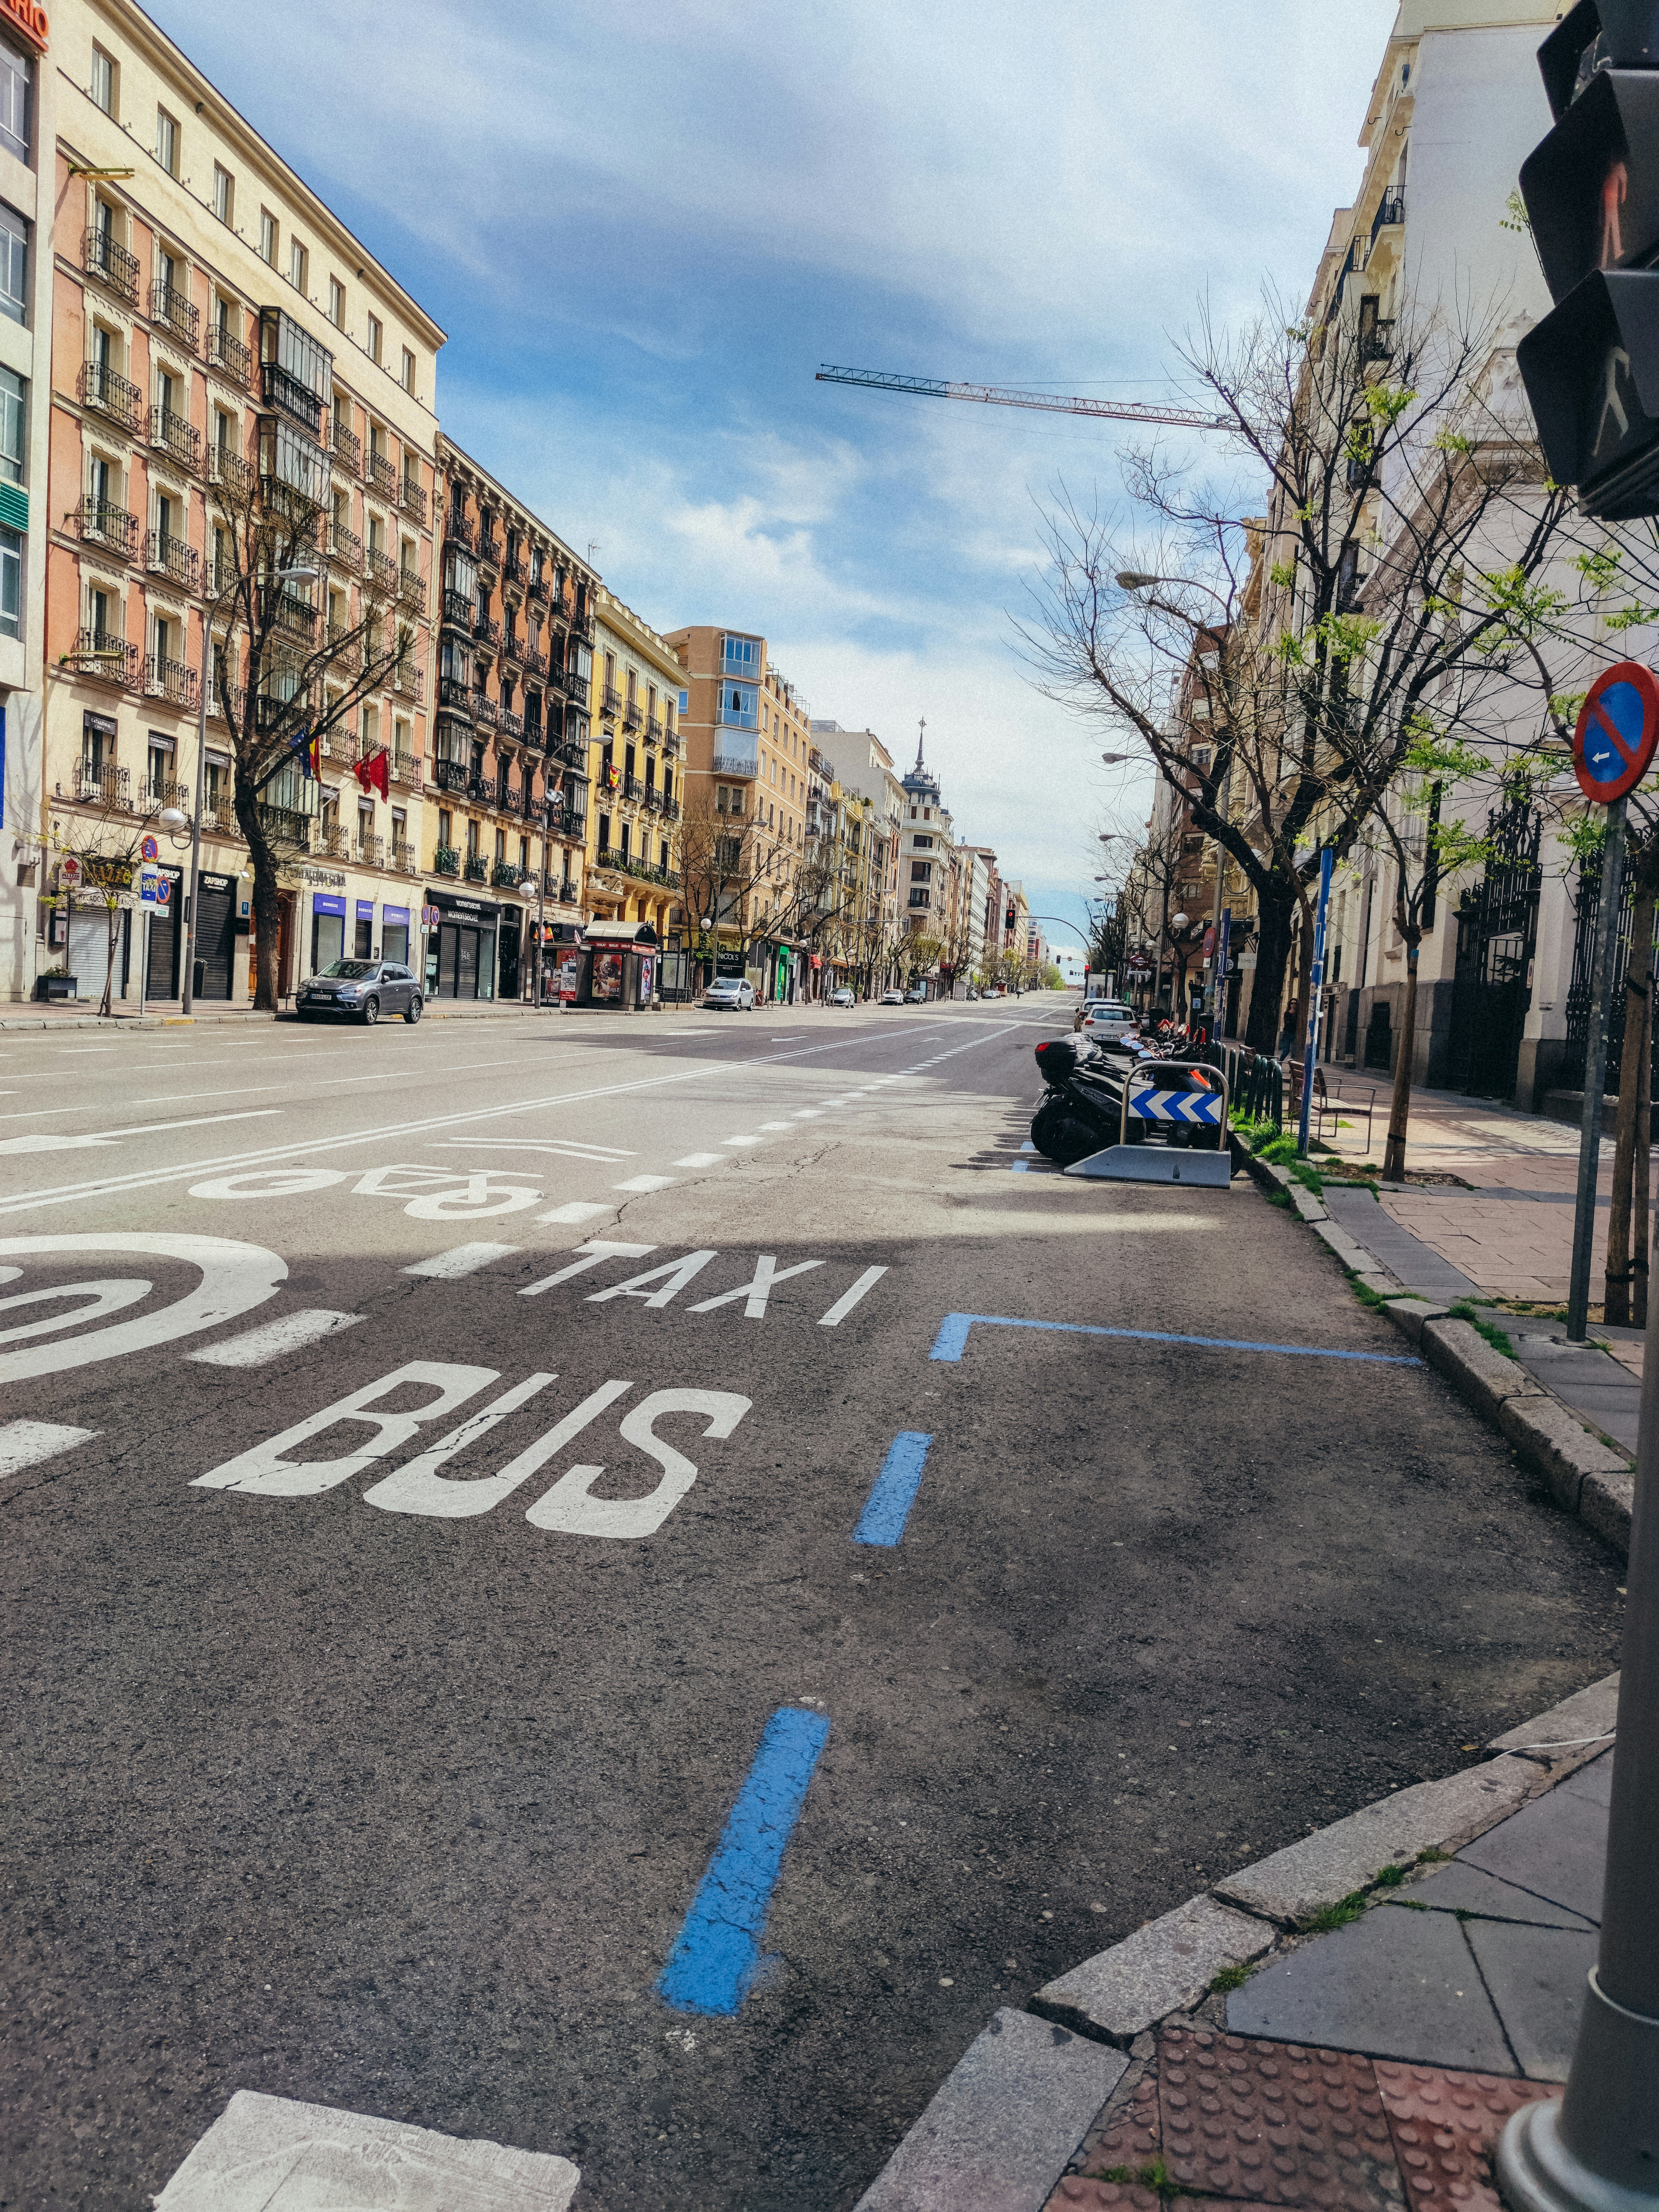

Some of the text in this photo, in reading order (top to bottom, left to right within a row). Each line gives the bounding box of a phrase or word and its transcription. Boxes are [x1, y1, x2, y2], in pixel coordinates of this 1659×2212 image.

[10, 0, 49, 38] RIO
[91, 718, 111, 728] CATALONIA
[150, 736, 169, 745] CATALONIA
[157, 868, 180, 879] APSHOP
[204, 876, 228, 886] ZAPSHOP
[78, 895, 105, 903] HELADOS
[447, 910, 478, 922] women'secret
[515, 1239, 890, 1326] TAXI
[186, 1360, 753, 1539] BUS
